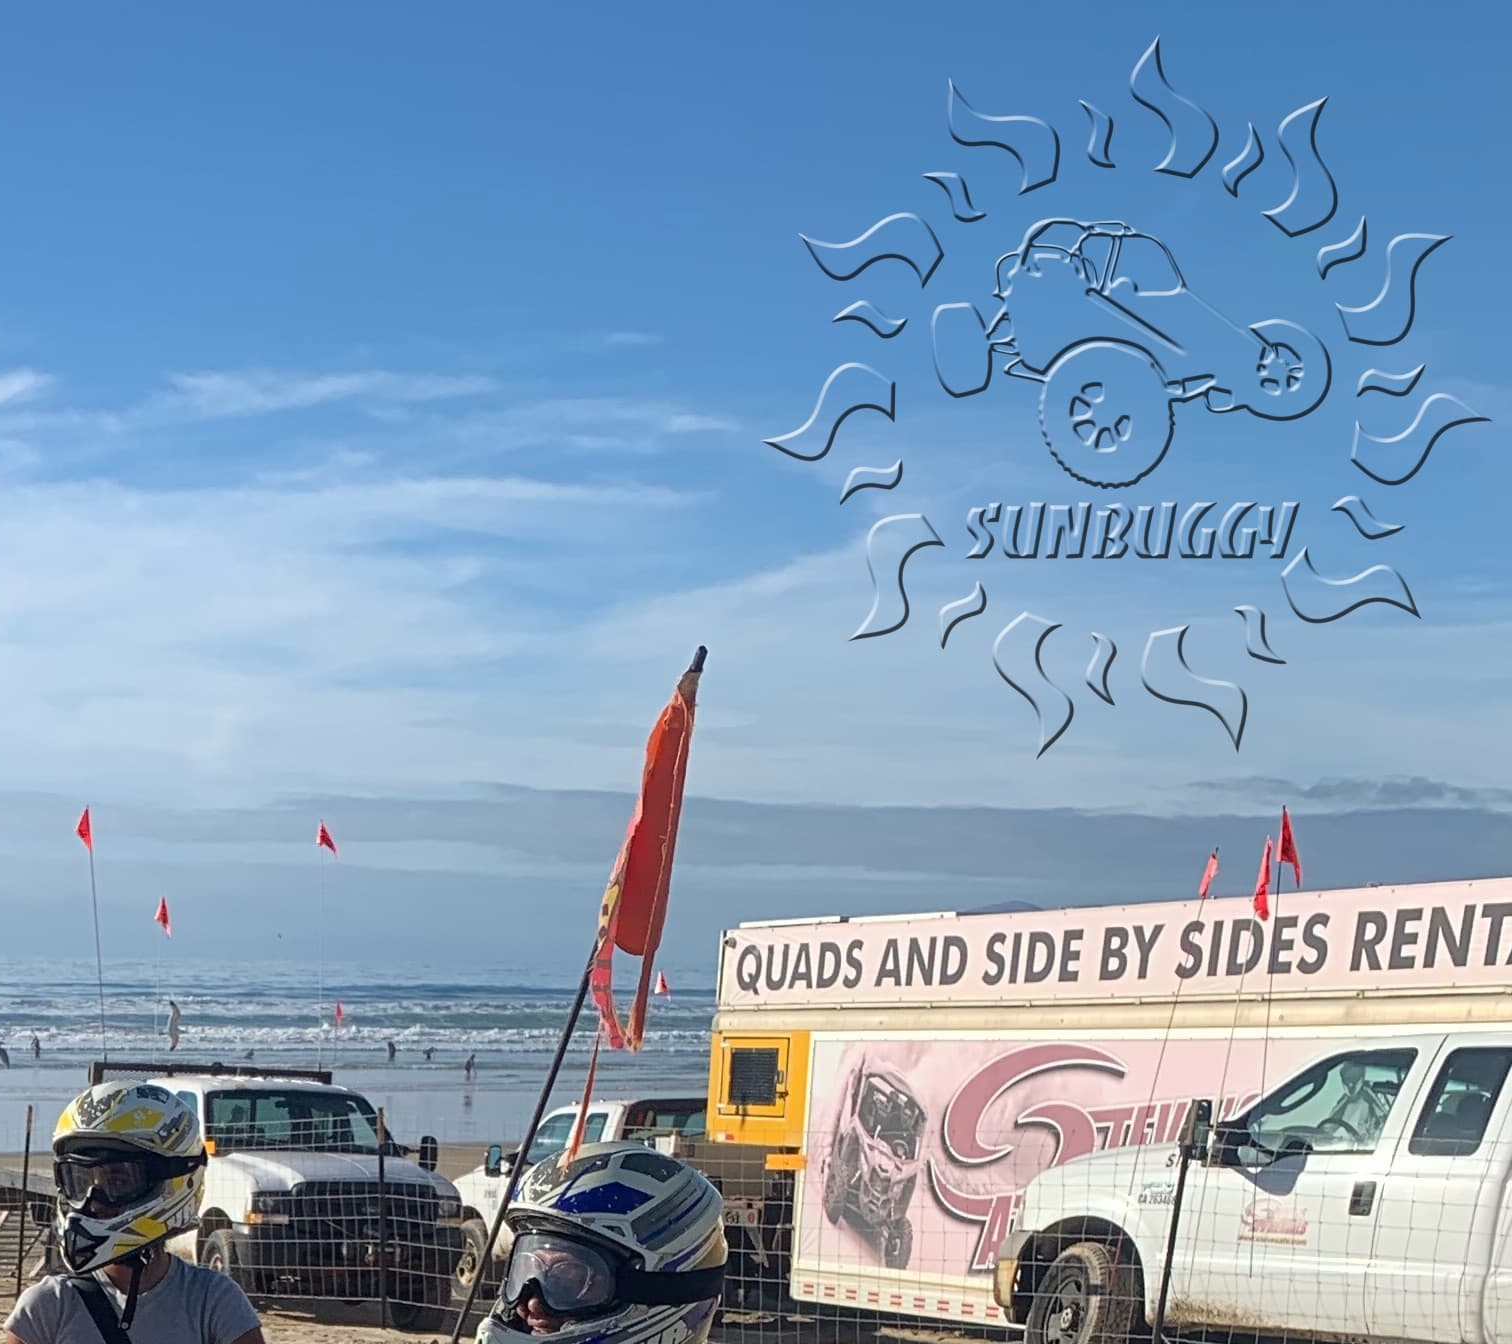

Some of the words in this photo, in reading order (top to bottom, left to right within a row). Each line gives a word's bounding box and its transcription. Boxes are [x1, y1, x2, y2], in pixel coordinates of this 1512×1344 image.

[736, 938, 865, 995] QUADS
[874, 935, 969, 988] AND
[981, 928, 1085, 986] SIDE
[1098, 923, 1164, 981] BY
[1174, 912, 1331, 979] SIDES
[1349, 902, 1512, 972] RENT
